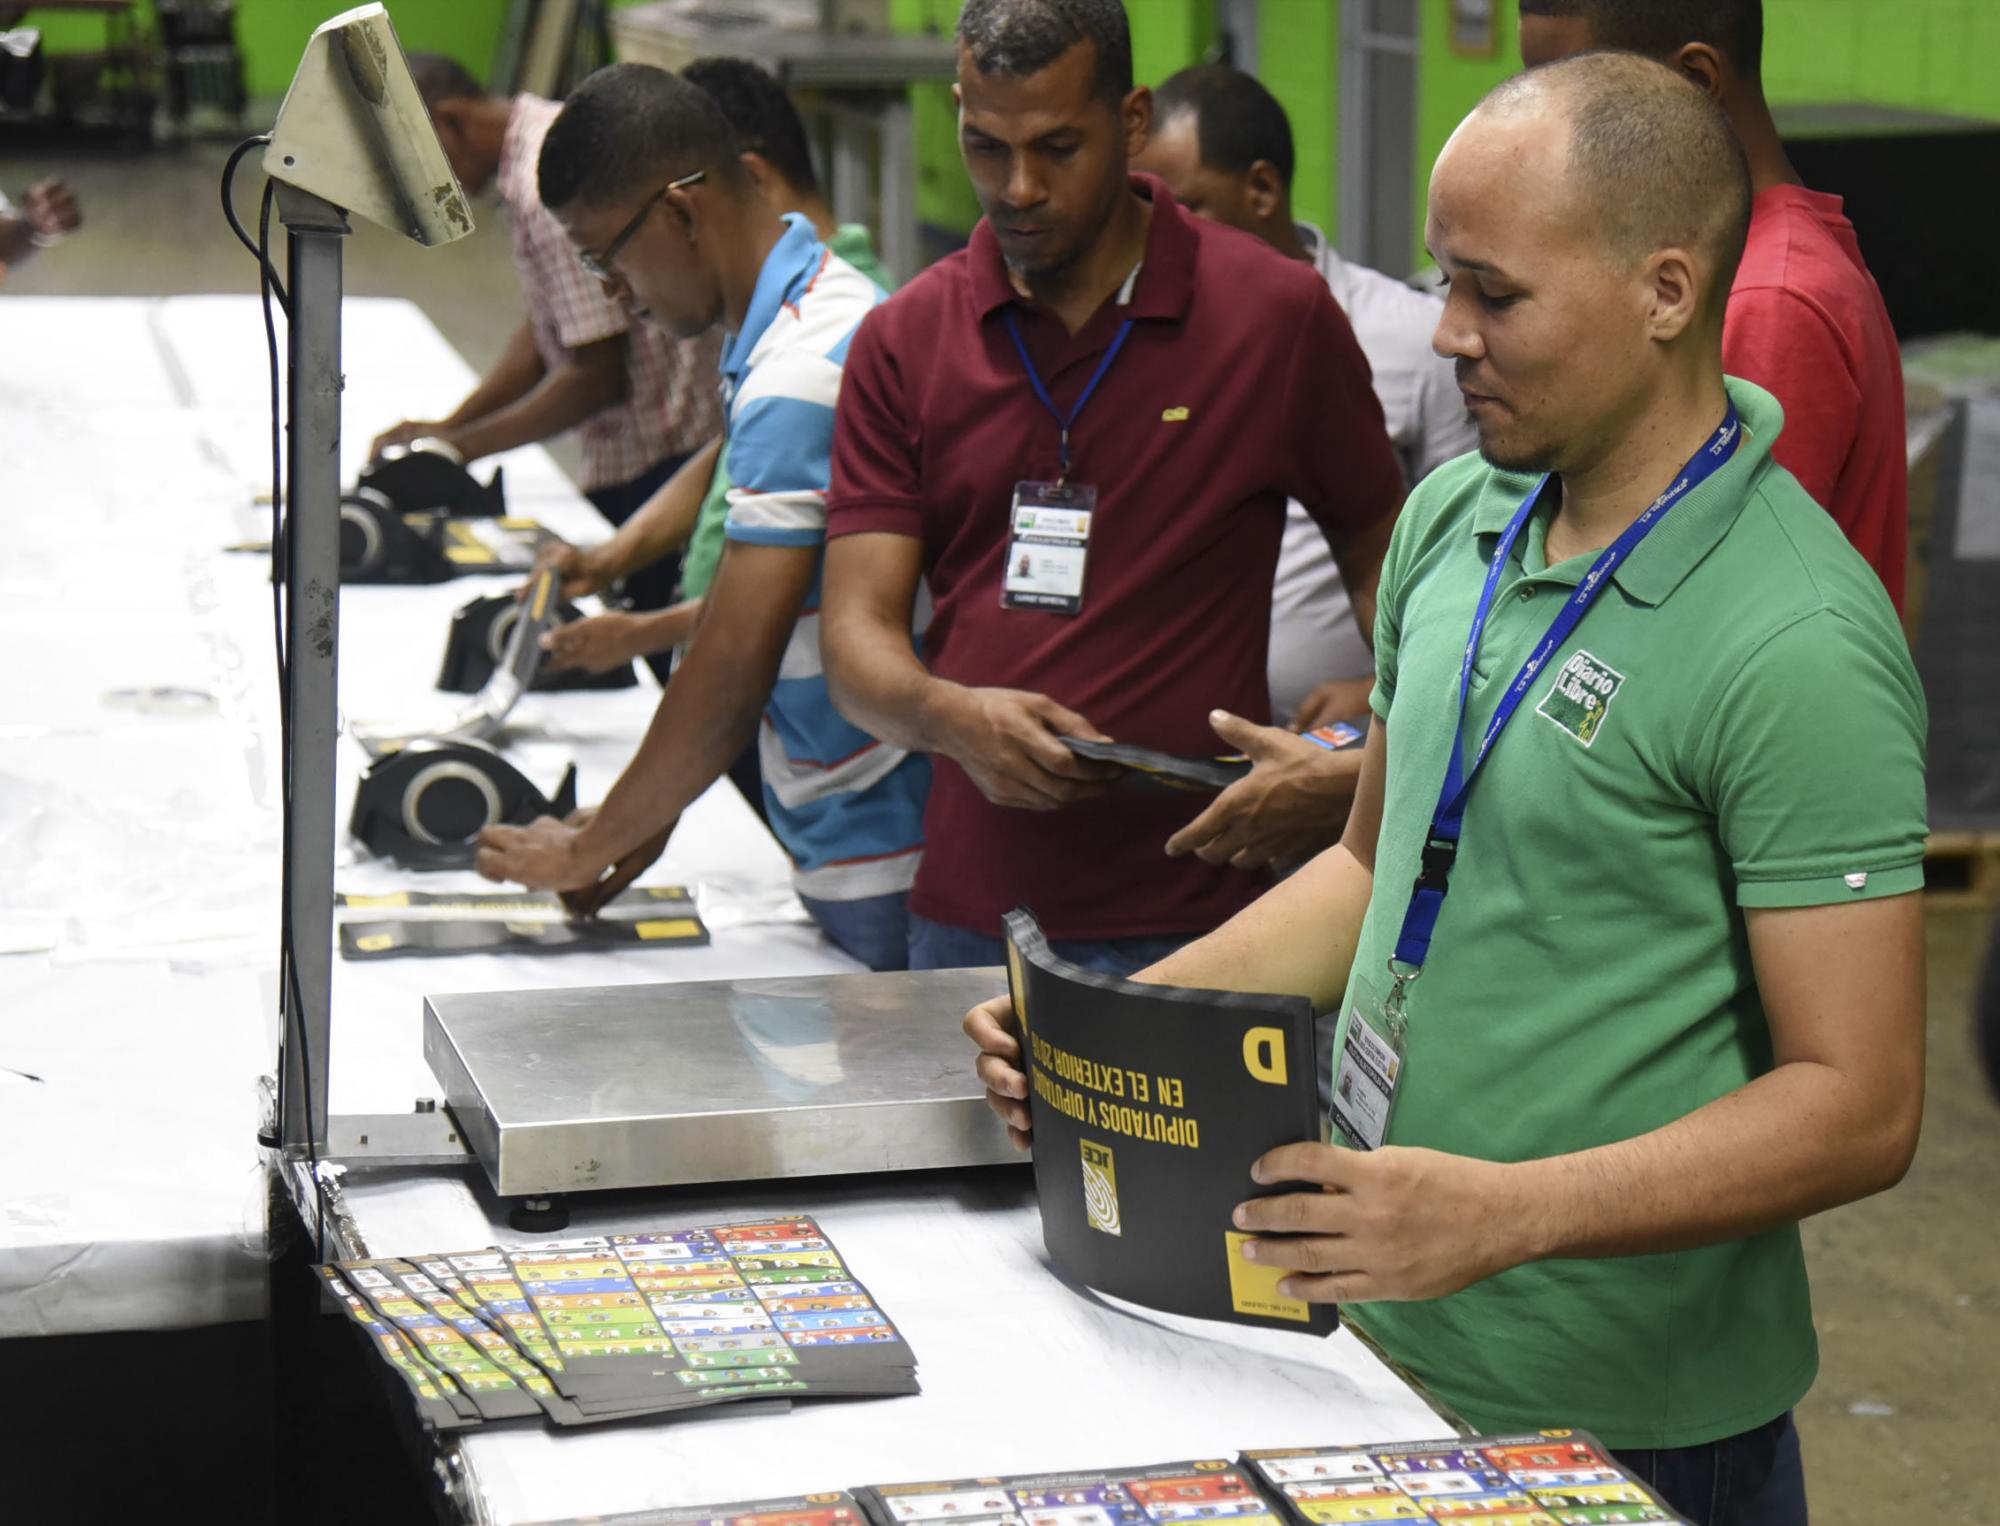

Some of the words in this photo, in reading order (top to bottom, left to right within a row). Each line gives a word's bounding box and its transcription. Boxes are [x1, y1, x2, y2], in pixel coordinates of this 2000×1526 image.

[1557, 671, 1597, 710] Libre
[1566, 654, 1613, 695] Diario
[1055, 1046, 1125, 1097] EXTERIOR
[1243, 1026, 1287, 1085] D
[1126, 1071, 1150, 1102] EL
[1157, 1076, 1184, 1109] EN
[1087, 1097, 1099, 1126] Y
[1099, 1102, 1199, 1148] DIPUTADOS
[1083, 1143, 1109, 1168] JCE
